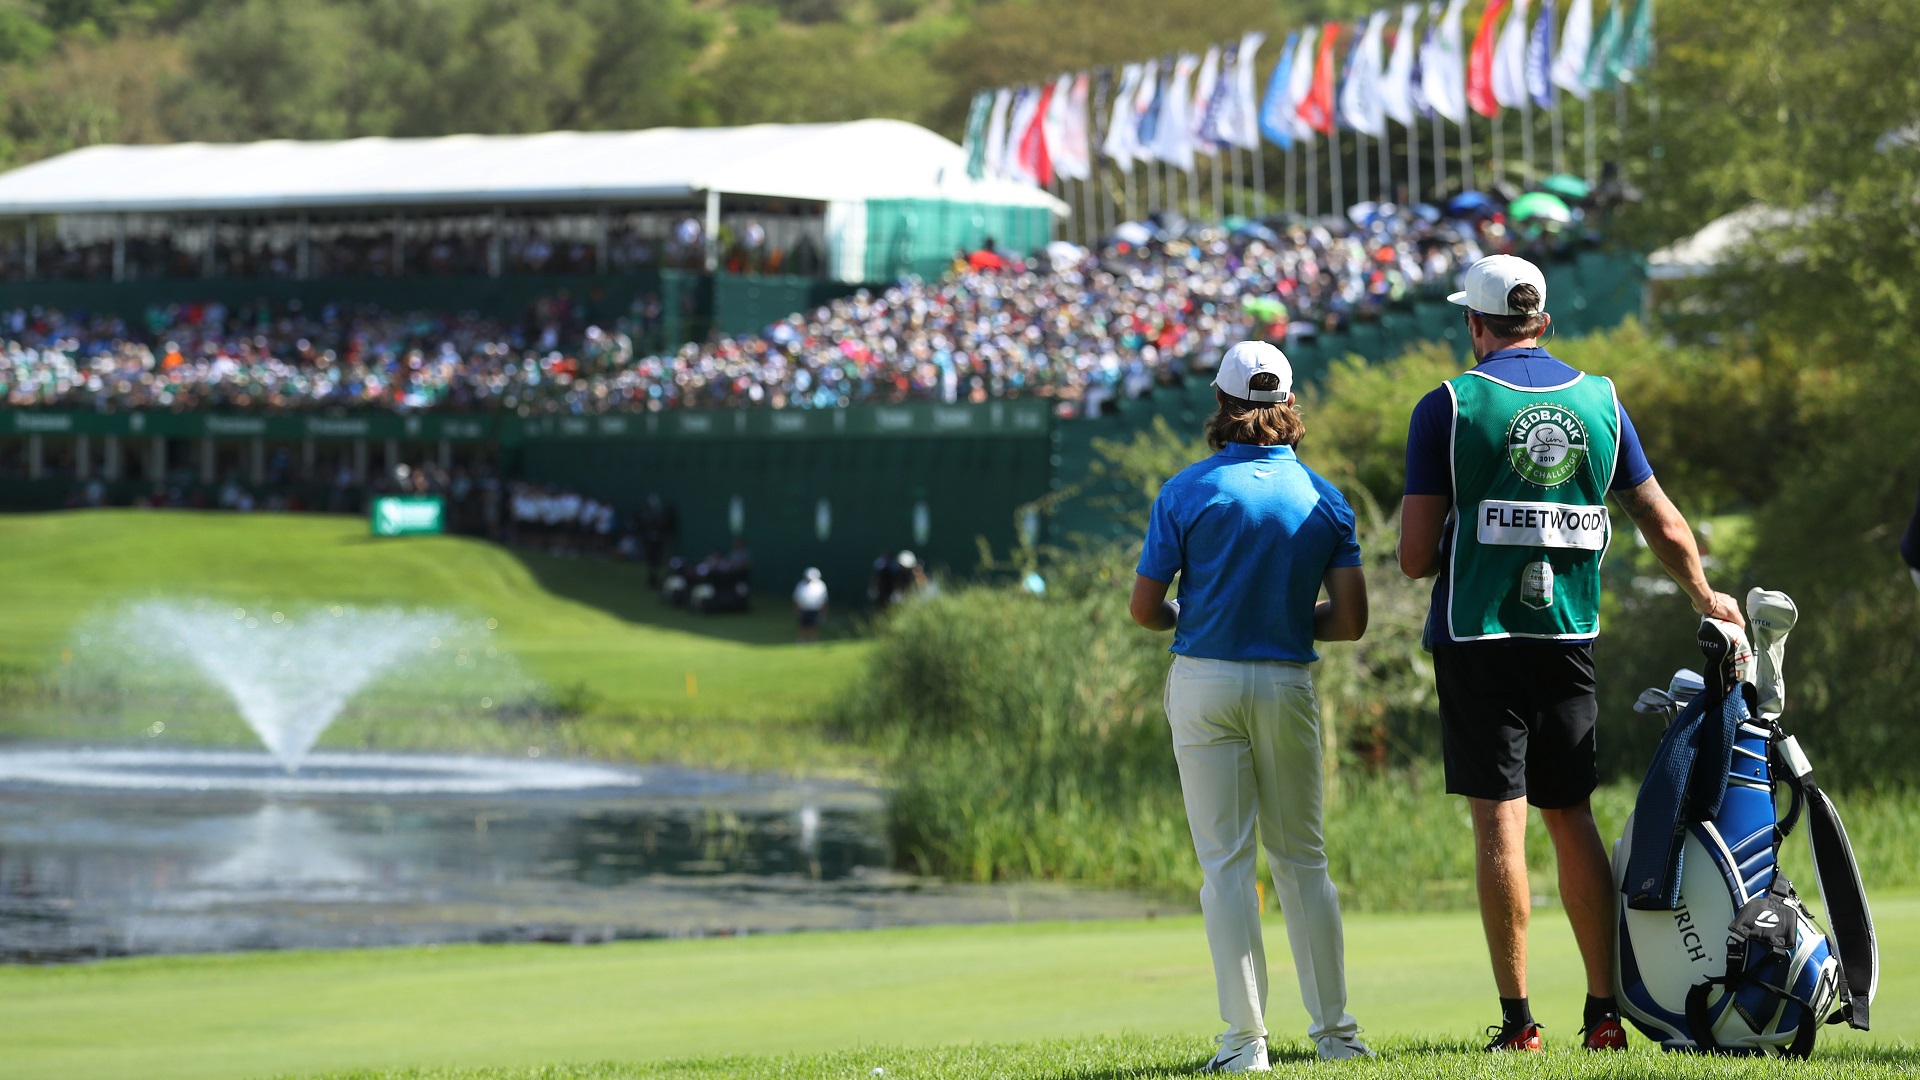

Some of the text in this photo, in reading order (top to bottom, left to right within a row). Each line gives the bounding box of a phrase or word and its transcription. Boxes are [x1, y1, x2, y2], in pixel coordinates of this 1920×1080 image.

[1514, 410, 1581, 441] NEDBANK
[1531, 428, 1565, 452] Sun
[1516, 451, 1578, 479] GOLF CHALLENGE
[1486, 508, 1600, 530] FLEETWOOD
[1751, 618, 1771, 628] TITCH
[1673, 891, 1706, 963] URICH
